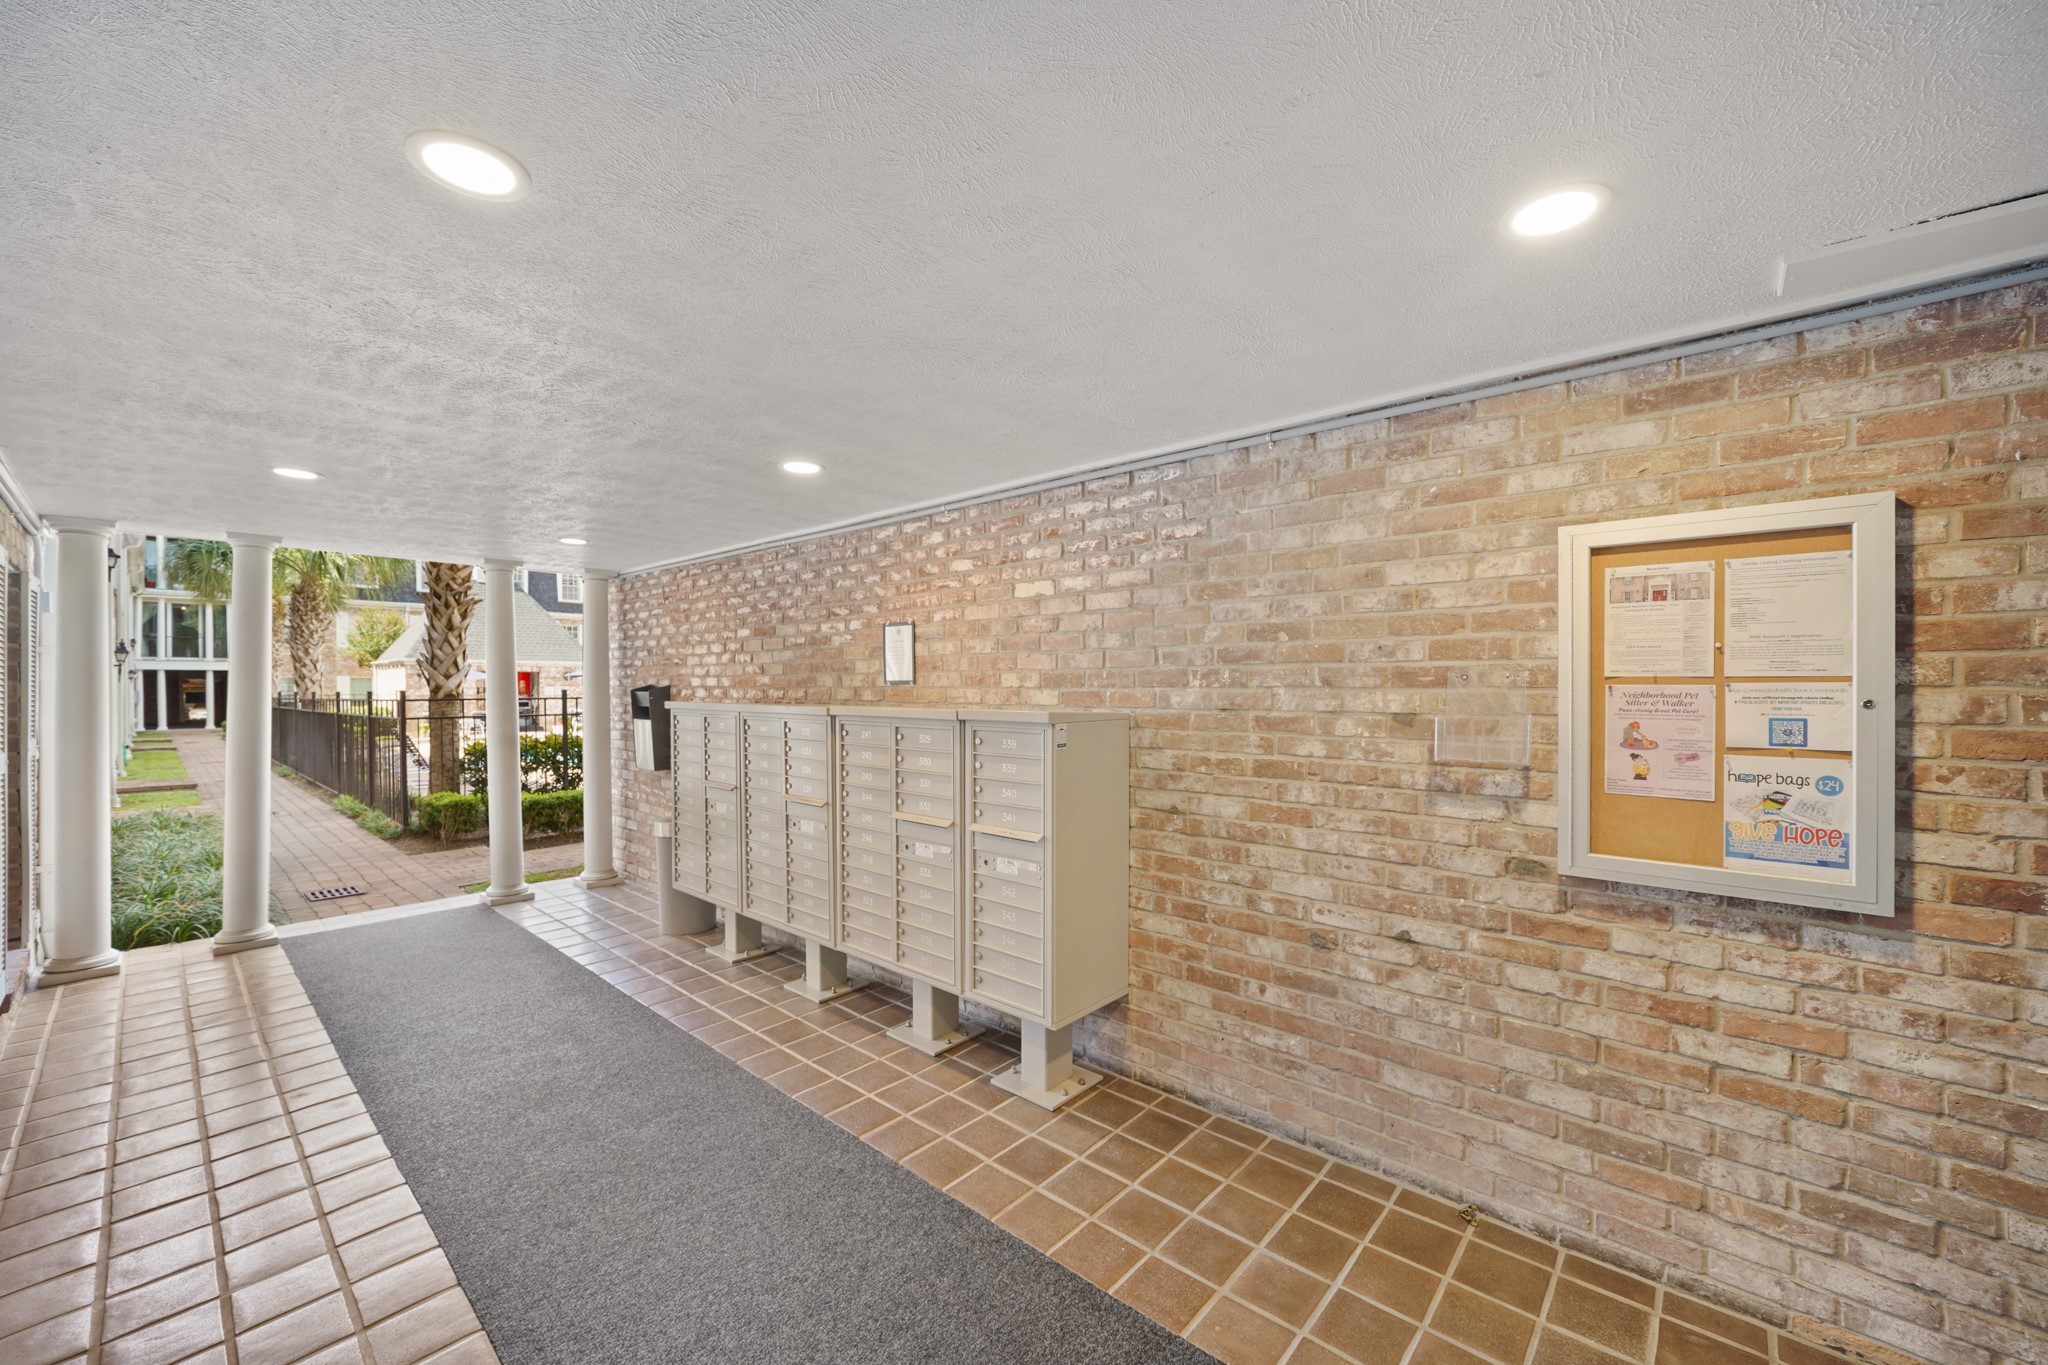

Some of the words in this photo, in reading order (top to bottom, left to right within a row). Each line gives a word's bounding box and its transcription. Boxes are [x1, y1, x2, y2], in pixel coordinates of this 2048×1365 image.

[1619, 691, 1682, 700] Neighborhood
[1624, 699, 1649, 707] Sitter
[1650, 699, 1660, 707] &
[1662, 699, 1695, 707] Walker
[861, 730, 872, 739] 241
[919, 734, 931, 744] 329
[1002, 739, 1017, 749] 338
[861, 751, 872, 760] 242
[919, 757, 931, 766] 330
[1001, 764, 1016, 773] 339
[861, 772, 872, 781] 243
[1776, 773, 1811, 790] bags
[920, 778, 931, 788] 331
[1817, 780, 1840, 792] $24
[862, 792, 872, 801] 244
[1001, 788, 1017, 798] 340
[919, 801, 931, 811] 332
[1002, 812, 1016, 822] 341
[862, 834, 873, 843] 246
[862, 854, 873, 864] 319
[920, 867, 932, 878] 333
[920, 890, 932, 900] 334
[1001, 887, 1016, 898] 342
[1001, 910, 1016, 922] 343
[1001, 935, 1016, 946] 344
